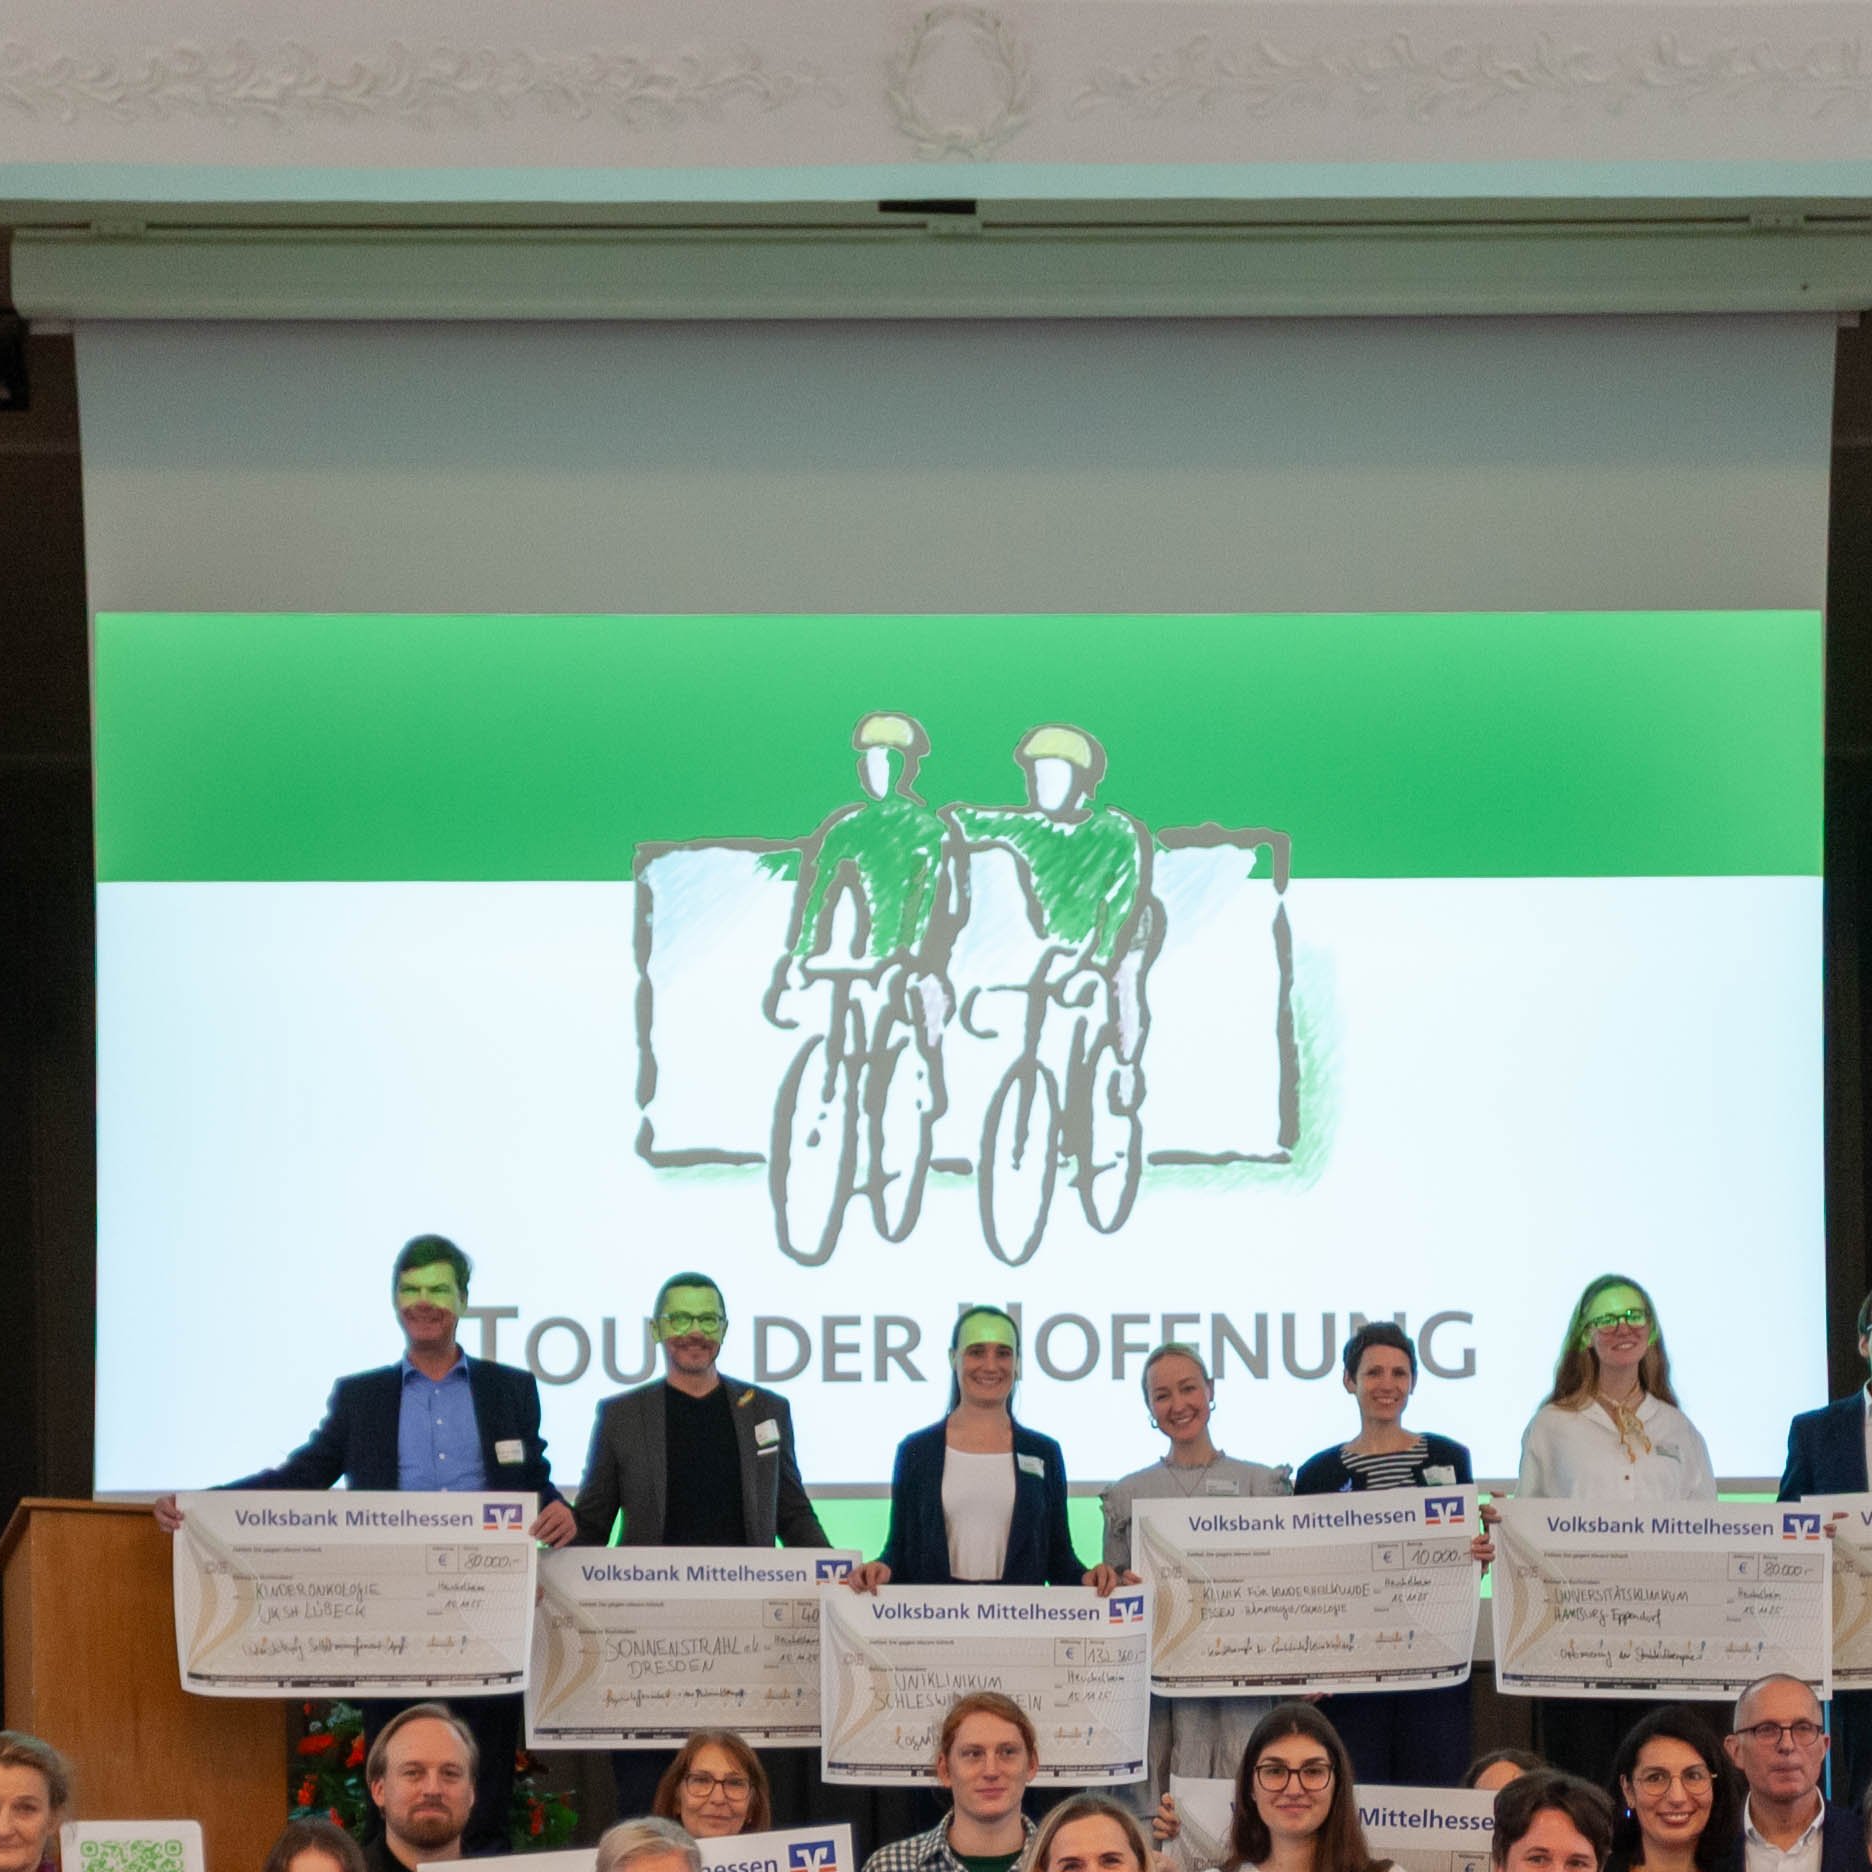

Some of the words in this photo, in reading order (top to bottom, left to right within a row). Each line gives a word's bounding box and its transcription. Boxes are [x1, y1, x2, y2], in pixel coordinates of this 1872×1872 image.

[753, 1314, 927, 1383] DER
[235, 1509, 338, 1528] Volksbank
[345, 1509, 474, 1527] Mittelhessen
[1188, 1513, 1286, 1533] Volksbank
[1292, 1508, 1417, 1530] Mittelhessen
[1546, 1516, 1645, 1534] Volksbank
[1651, 1516, 1775, 1537] Mittelhessen
[437, 1555, 448, 1567] €
[1382, 1551, 1393, 1564] €
[581, 1564, 680, 1582] Volksbank
[685, 1565, 808, 1583] Mittelhessen
[1738, 1561, 1748, 1574] €
[773, 1608, 783, 1622] €
[871, 1602, 971, 1621] Volksbank
[976, 1602, 1101, 1622] Mittelhessen
[1064, 1647, 1074, 1660] €
[627, 1659, 715, 1680] DRESDEN
[894, 1671, 1003, 1690] UNIKLINIKUM
